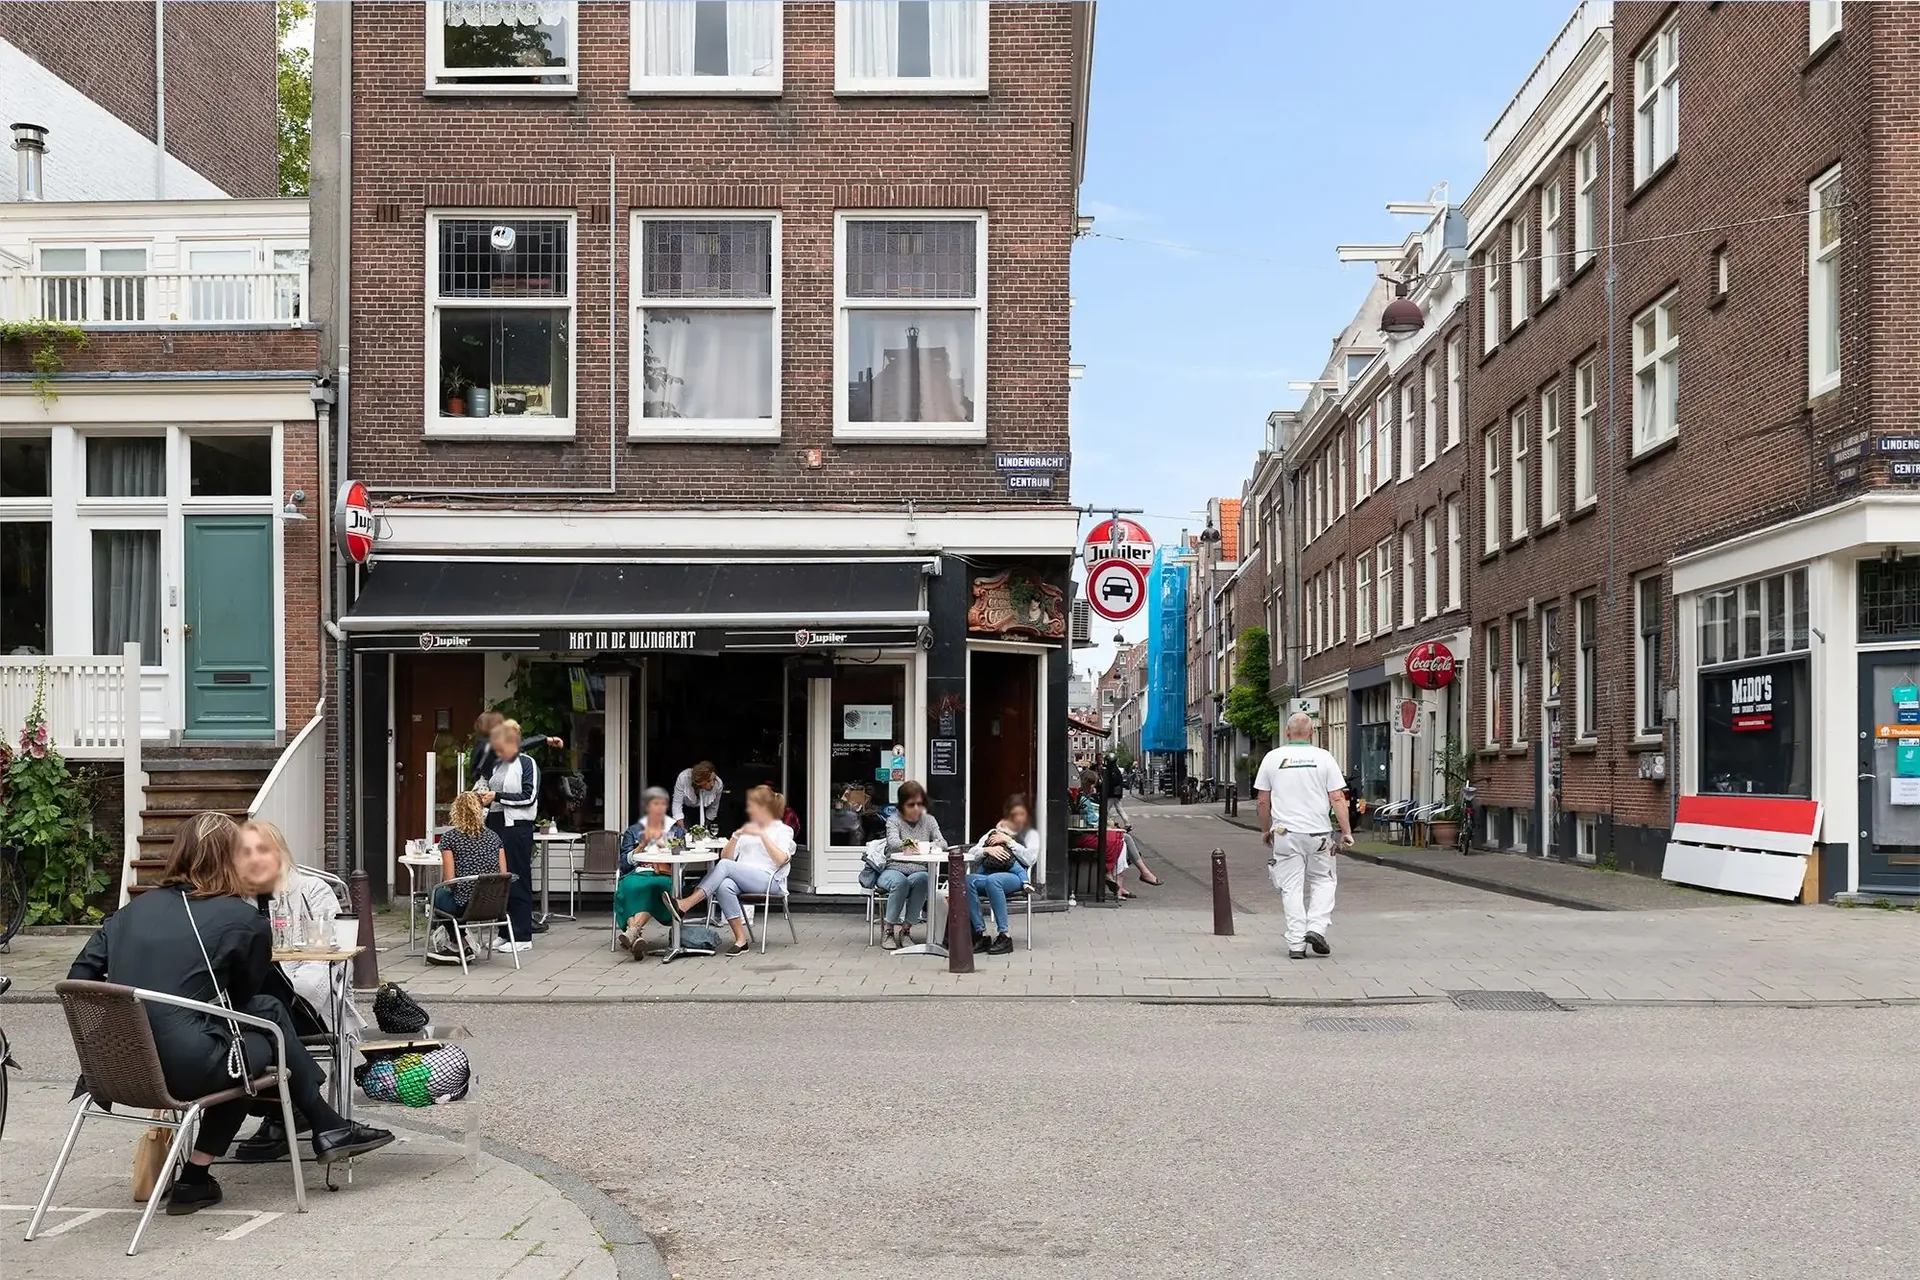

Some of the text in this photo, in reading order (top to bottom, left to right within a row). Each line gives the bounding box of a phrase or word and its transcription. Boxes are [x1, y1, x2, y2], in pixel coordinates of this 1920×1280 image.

[998, 457, 1064, 467] LINDENGRACHT
[1010, 477, 1050, 487] CENTRUM
[433, 636, 472, 647] Jupiler
[569, 631, 696, 649] KAT IN DE WIJNGAERT
[809, 633, 848, 643] Jupiler
